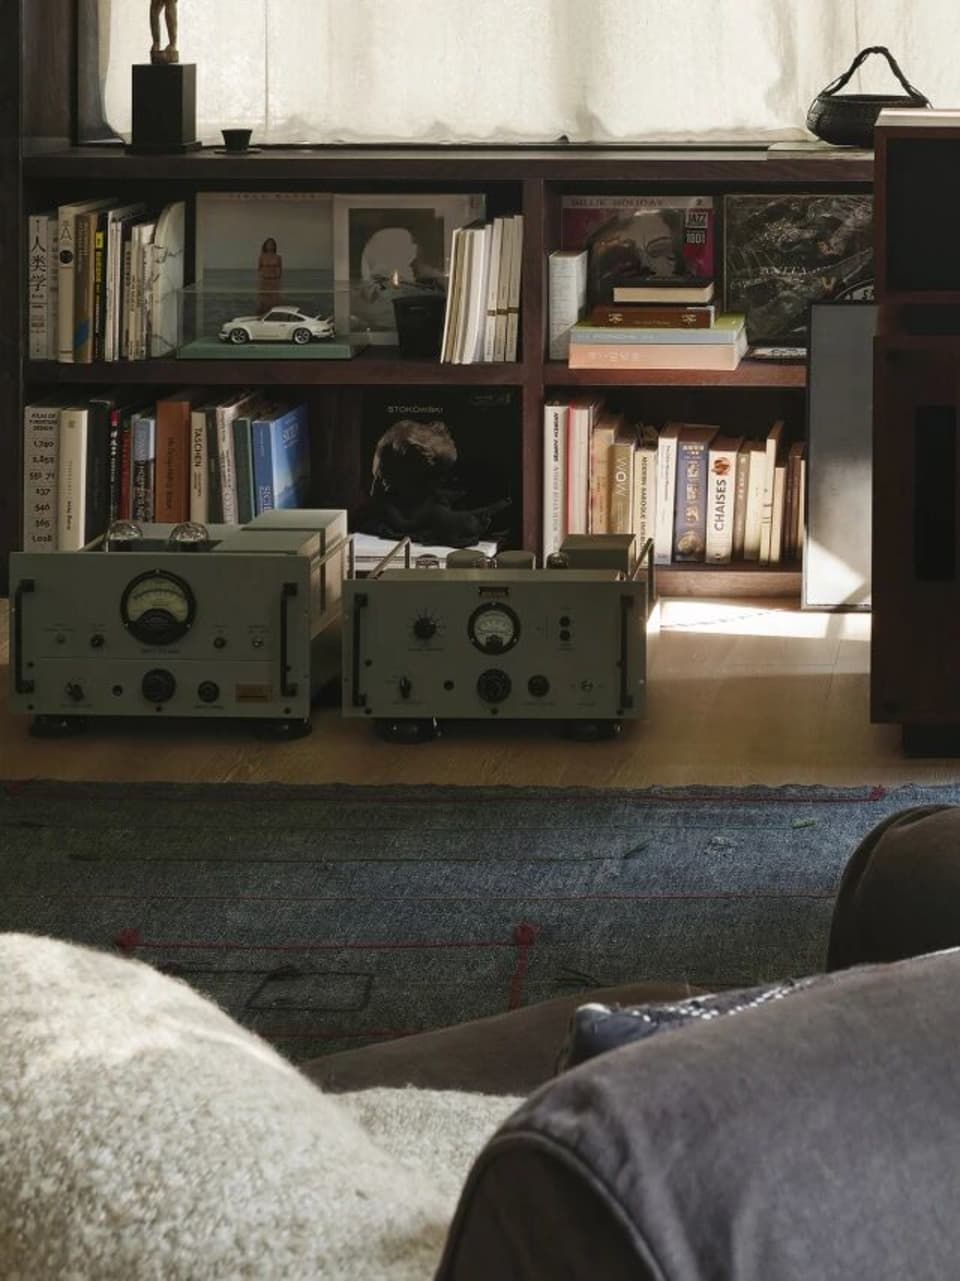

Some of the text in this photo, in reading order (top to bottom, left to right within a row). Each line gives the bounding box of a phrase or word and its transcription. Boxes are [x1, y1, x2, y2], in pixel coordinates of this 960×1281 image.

[31, 235, 47, 292] 人类学
[194, 427, 203, 467] TASCHEN
[616, 457, 627, 496] WOW
[714, 479, 727, 531] CHAISES
